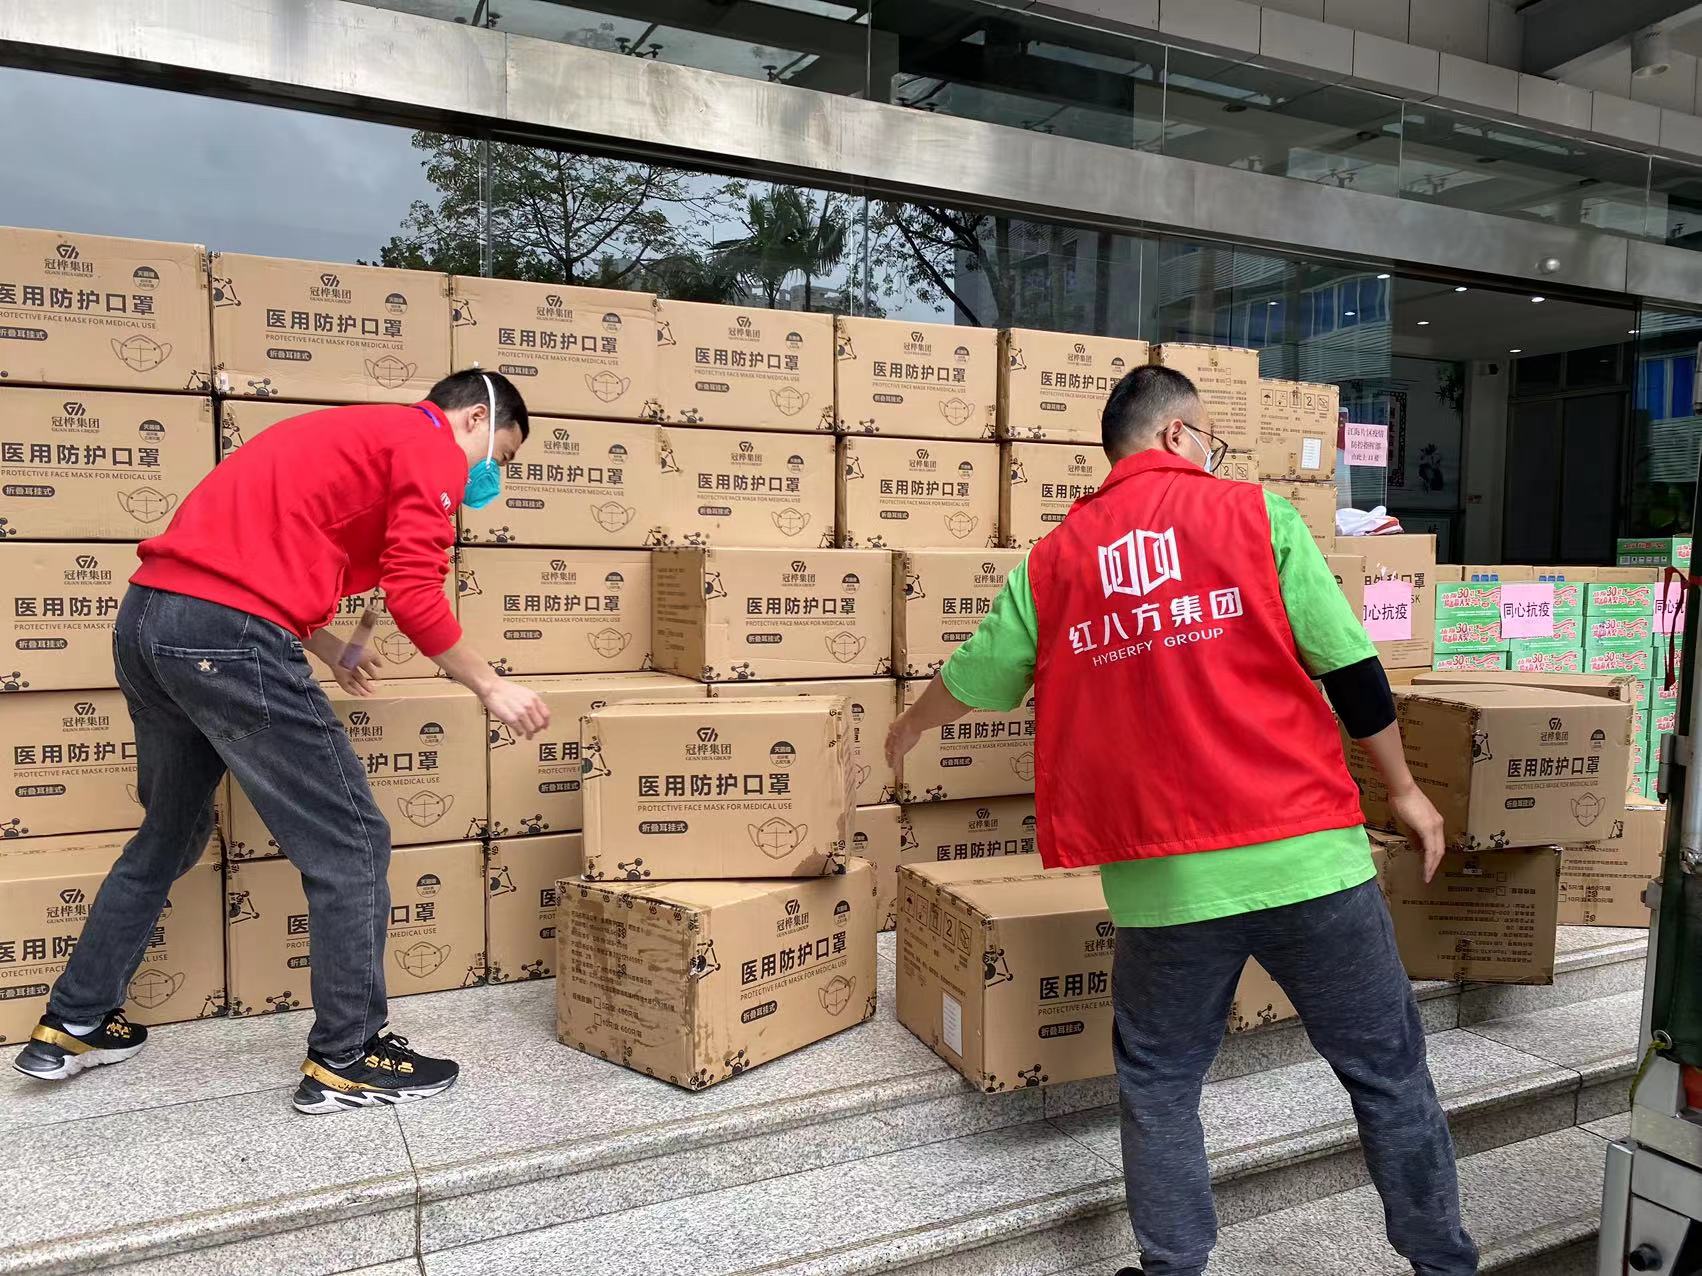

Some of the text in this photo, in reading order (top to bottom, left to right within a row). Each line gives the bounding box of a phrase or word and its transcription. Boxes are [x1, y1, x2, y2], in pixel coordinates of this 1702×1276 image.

[44, 258, 93, 273] 冠桦集团
[310, 286, 351, 300] 冠桦集团
[0, 310, 41, 320] ROTECTIVE
[43, 314, 62, 322] FACE
[64, 316, 87, 324] MASK
[106, 319, 140, 328] MEDICAL
[536, 306, 572, 319] 冠桦集团
[267, 309, 402, 338] 医用防护口罩
[728, 327, 760, 338] 冠桦集团
[265, 334, 307, 343] PROTECTIVE
[361, 341, 390, 349] MEDICAL
[499, 328, 617, 354] 医用防护口罩
[903, 342, 931, 353] 冠桦集团
[695, 347, 799, 371] 医用防护口罩
[1067, 353, 1092, 363] 冠桦集团
[873, 361, 965, 383] 医用防护口罩
[51, 416, 99, 429] 冠桦集团
[543, 440, 579, 452] 冠桦集团
[1, 442, 160, 467] 医用防护口罩
[731, 452, 762, 462] 冠桦集团
[909, 459, 936, 469] 冠桦集团
[1068, 465, 1092, 474] 冠桦集团
[0, 469, 49, 477] PROTECTIVE
[506, 462, 623, 485] 医用防护口罩
[698, 473, 800, 492] 医用防护口罩
[880, 479, 969, 497] 医用防护口罩
[1042, 484, 1098, 500] 医用防护
[64, 570, 111, 580] 冠桦集团
[541, 572, 576, 581] 冠桦集团
[782, 573, 815, 583] 冠桦集团
[974, 575, 1003, 583] 冠桦集团
[15, 597, 117, 616] 医用防护
[504, 595, 619, 611] 医用防护口罩
[747, 598, 855, 614] 医用防护口罩
[943, 598, 990, 614] 医用防
[1504, 602, 1550, 618] 同心抗疫
[1069, 586, 1244, 655] 红八方集团
[1093, 628, 1224, 666] HYBERFY GROUP
[62, 716, 109, 727] 冠桦集团
[1540, 732, 1568, 741] 冠桦集团
[14, 741, 137, 765] 医用防护口
[685, 744, 731, 755] 冠桦集团
[356, 751, 438, 773] 护口罩
[1507, 756, 1600, 777] 医用防护口罩
[13, 770, 60, 778] PROTECTIVE
[639, 773, 790, 796] 医用防护口罩
[637, 804, 682, 812] PROTECTIVE
[968, 819, 998, 829] 冠桦集团
[287, 902, 435, 935] 医口罩
[777, 912, 808, 932] 冠桦集团
[390, 927, 437, 938] MEDICAL USE
[0, 926, 166, 964] 医用防罩
[1084, 937, 1114, 952] 冠桦集
[45, 954, 168, 973] FACE USE
[742, 931, 846, 985] 医用防护口罩
[740, 958, 847, 1002] PROTECTIVE FACE MASK FOR MEDICAL USE
[1039, 970, 1107, 1000] 医用防
[1038, 1002, 1097, 1016] PROTECTIVE FACE
